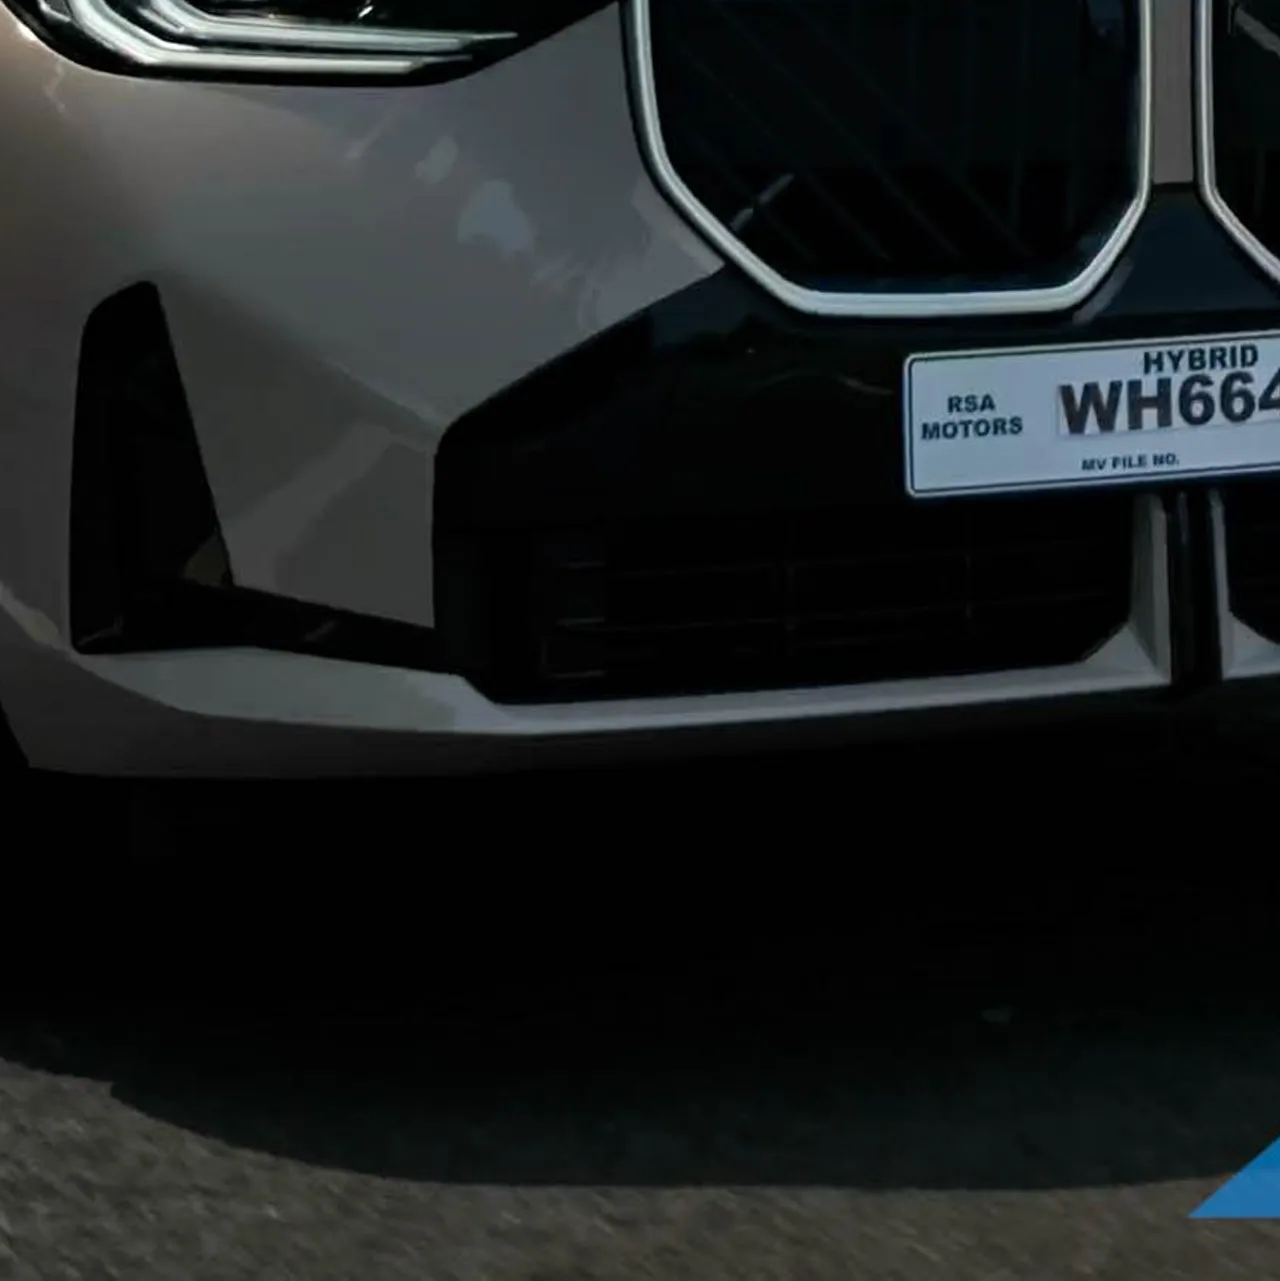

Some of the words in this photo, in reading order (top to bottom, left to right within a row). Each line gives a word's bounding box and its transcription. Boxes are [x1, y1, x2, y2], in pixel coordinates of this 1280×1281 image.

[1143, 345, 1258, 374] HYBRID
[947, 394, 996, 414] RSA
[921, 416, 1023, 440] MOTORS
[1081, 458, 1108, 472] MV
[1111, 455, 1147, 470] FILE
[1152, 453, 1180, 467] NO.
